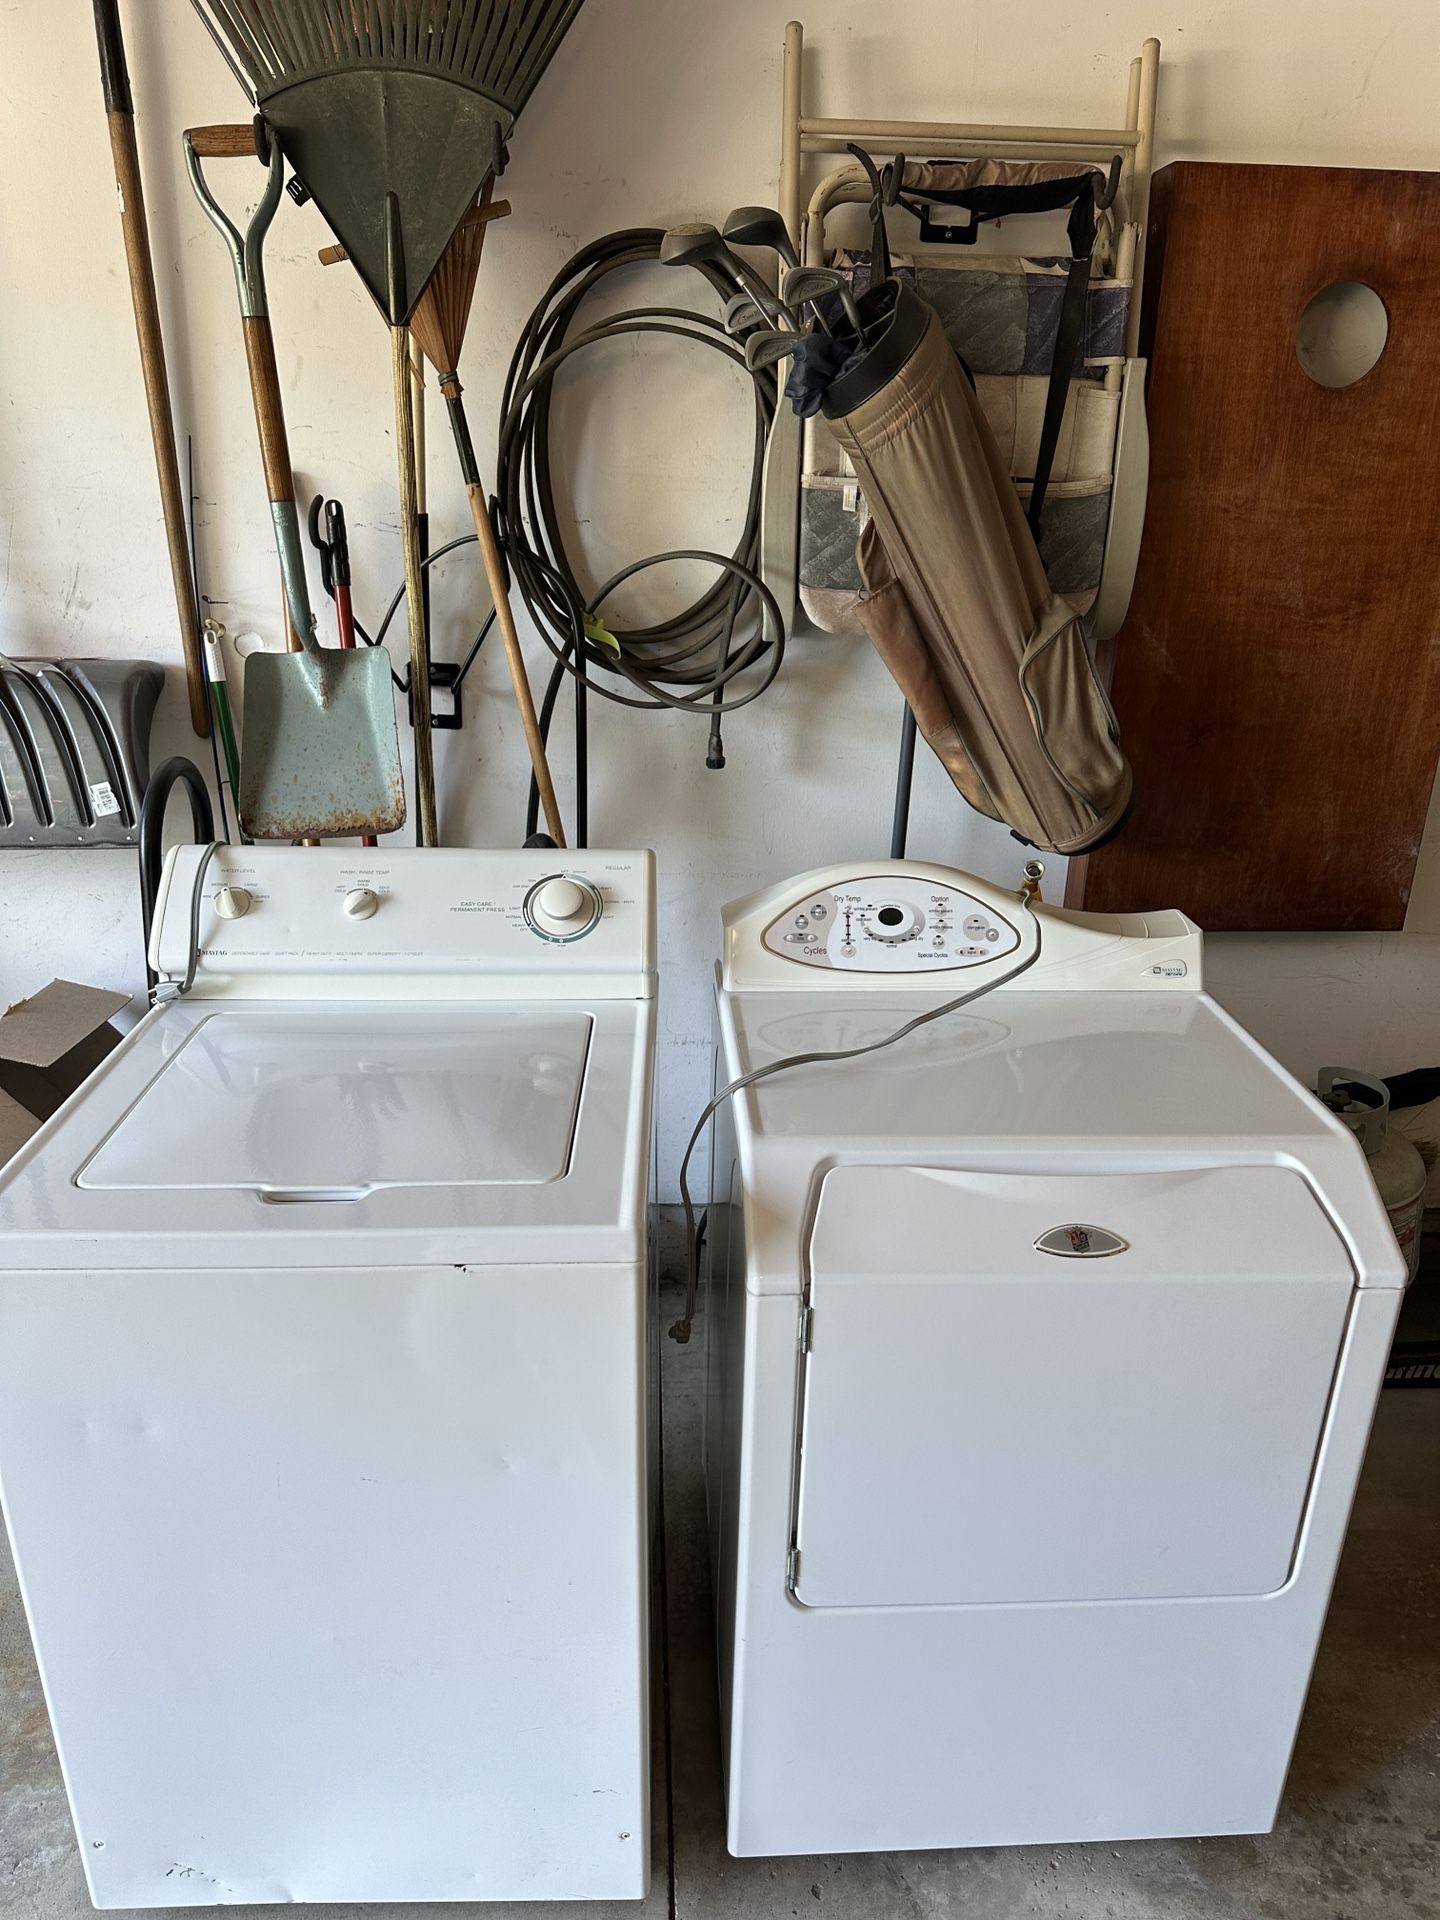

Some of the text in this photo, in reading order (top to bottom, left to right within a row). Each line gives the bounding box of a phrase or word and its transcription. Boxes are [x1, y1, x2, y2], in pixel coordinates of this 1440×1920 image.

[833, 894, 861, 904] Dry Temp
[930, 895, 950, 903] Option
[803, 945, 828, 956] Cycles
